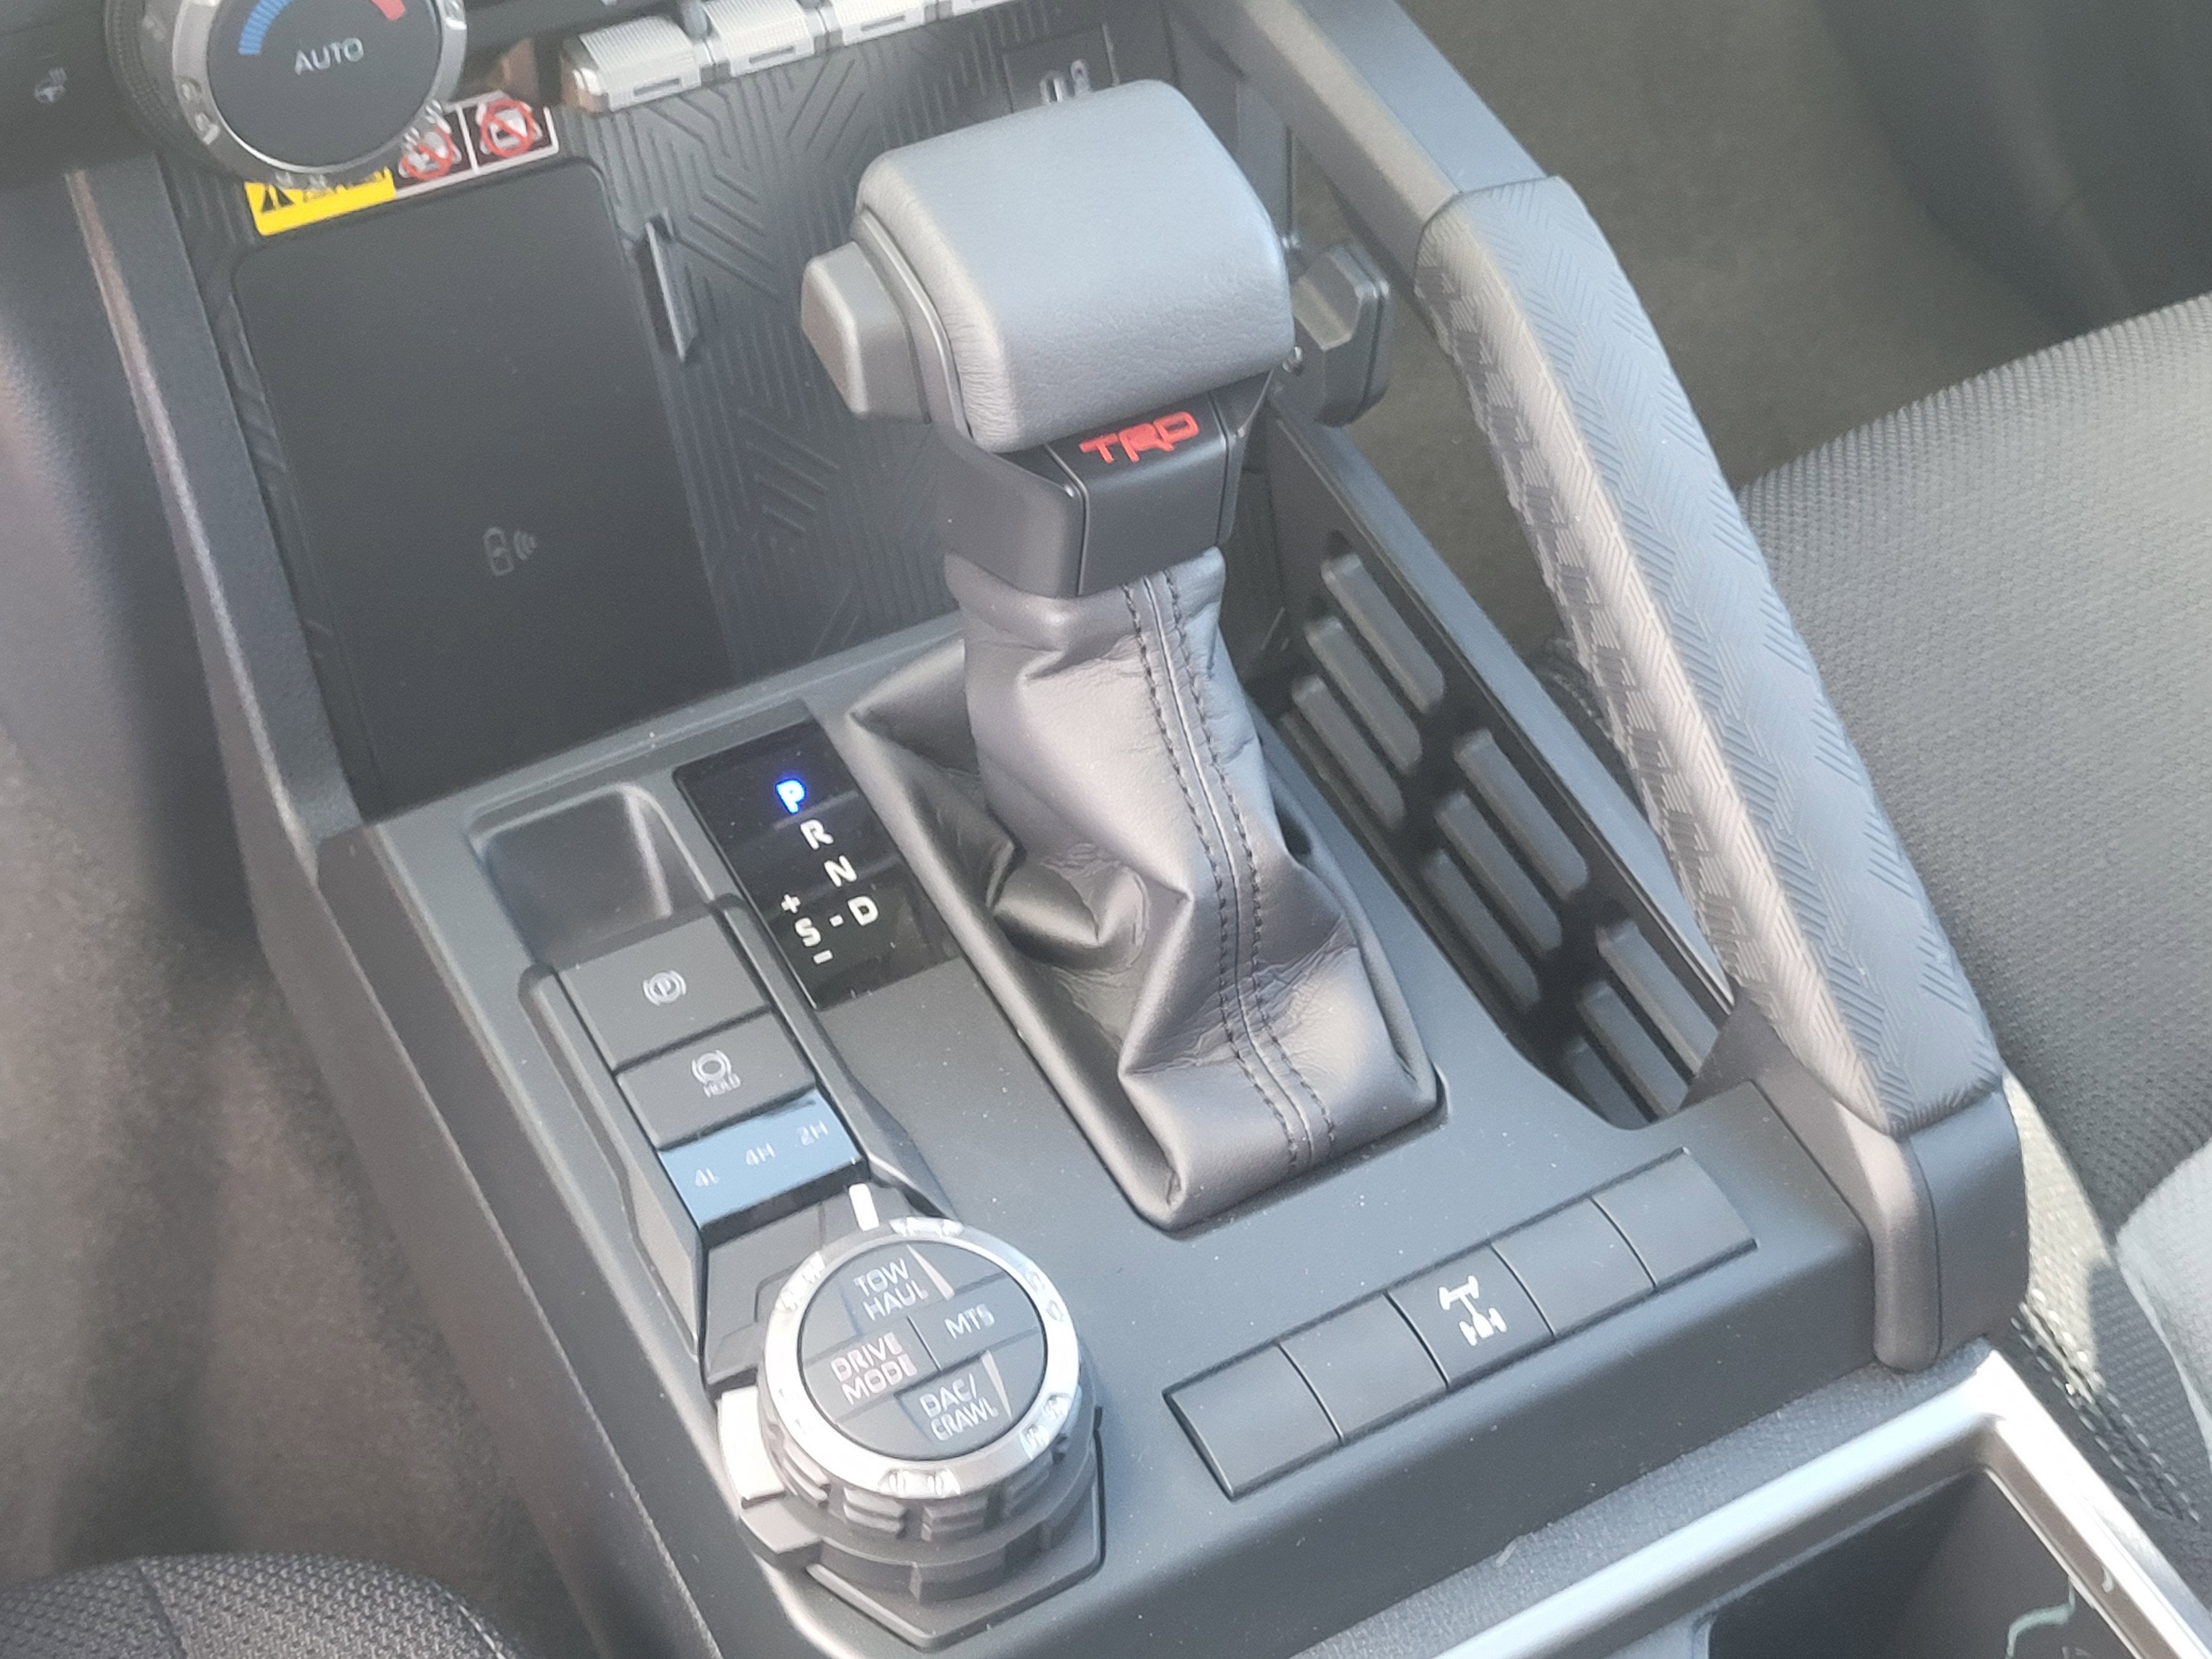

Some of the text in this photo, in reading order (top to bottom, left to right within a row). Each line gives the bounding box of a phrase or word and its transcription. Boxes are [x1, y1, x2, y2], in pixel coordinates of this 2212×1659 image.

[295, 38, 364, 76] AUTO
[1079, 411, 1199, 463] TRD
[776, 779, 806, 814] P
[800, 819, 834, 851] R
[823, 855, 857, 888] N
[795, 917, 822, 947] S
[847, 895, 879, 926] D
[796, 1120, 828, 1146] 2H
[746, 1142, 775, 1166] 4H
[853, 1257, 909, 1297] TOW
[863, 1279, 929, 1321] HAUL
[944, 1303, 995, 1339] MTS
[830, 1332, 903, 1382] DRIVE
[841, 1353, 918, 1405] MODE
[919, 1372, 977, 1418] DAC/
[931, 1397, 999, 1441] CRAWL
